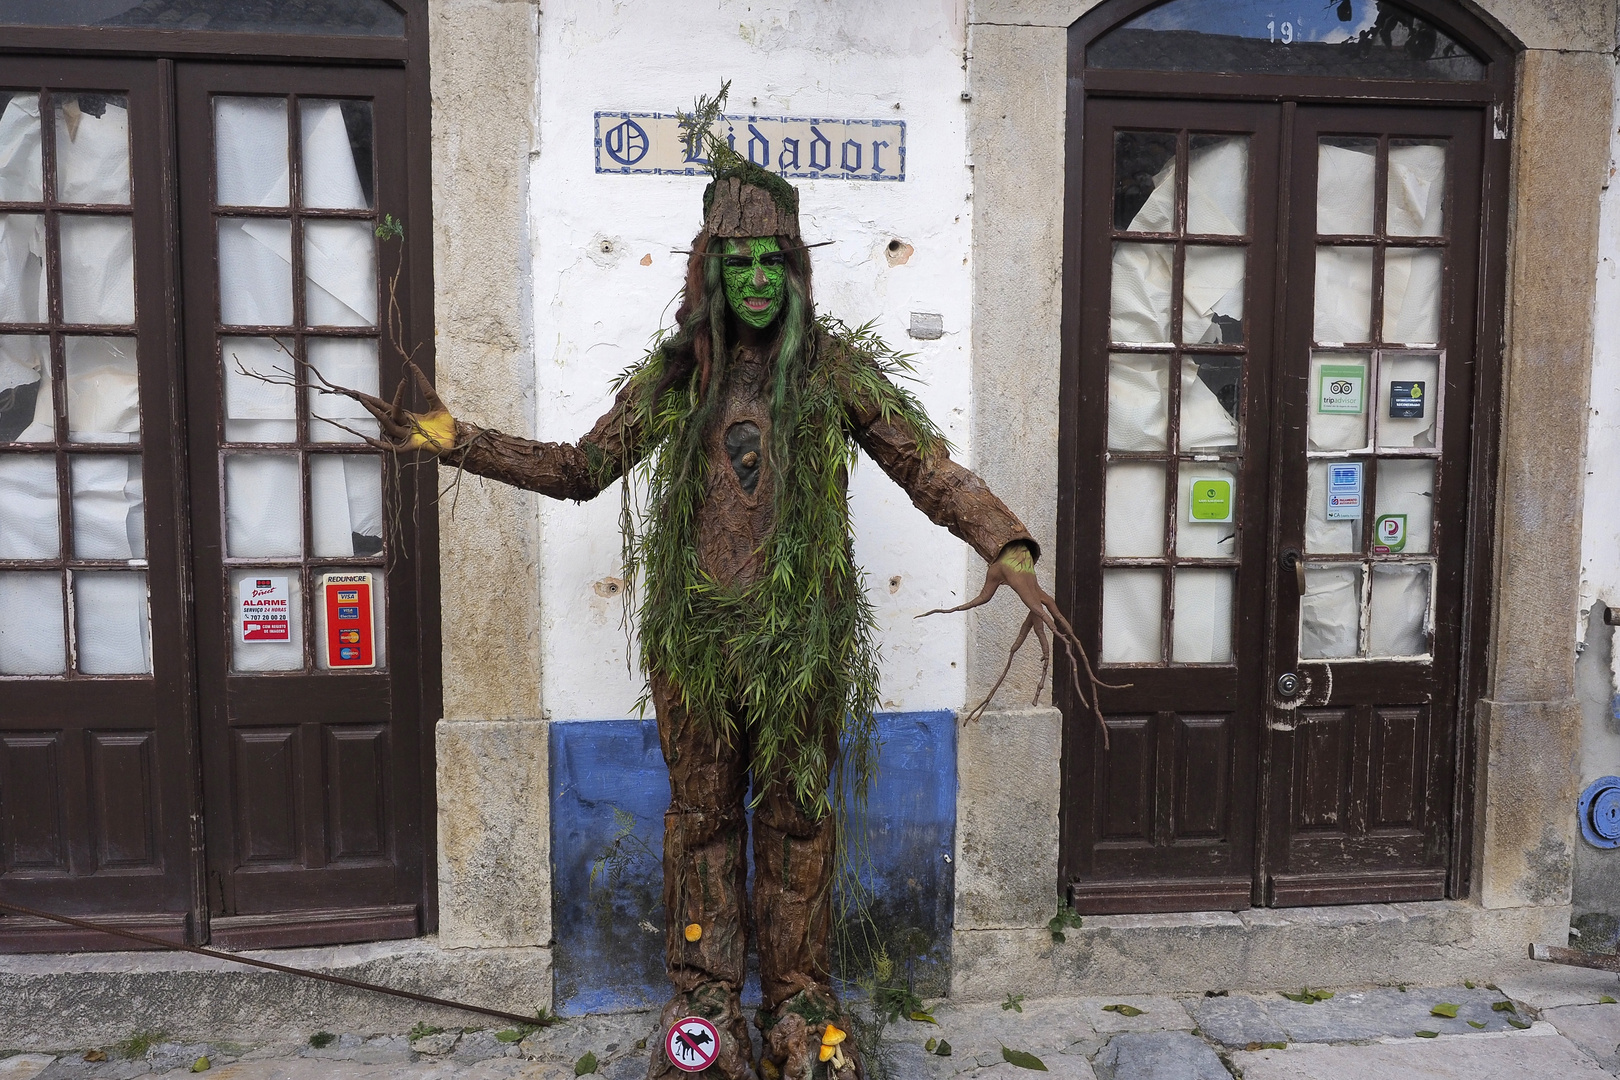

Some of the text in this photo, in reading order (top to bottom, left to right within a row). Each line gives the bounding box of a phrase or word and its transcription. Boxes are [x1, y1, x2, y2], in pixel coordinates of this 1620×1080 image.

[1266, 20, 1294, 45] 19
[604, 118, 890, 174] O Lidador
[1323, 396, 1357, 405] tripadvisor
[1334, 470, 1356, 483] MB
[327, 575, 367, 583] REDUNICRE
[252, 586, 276, 598] Direct
